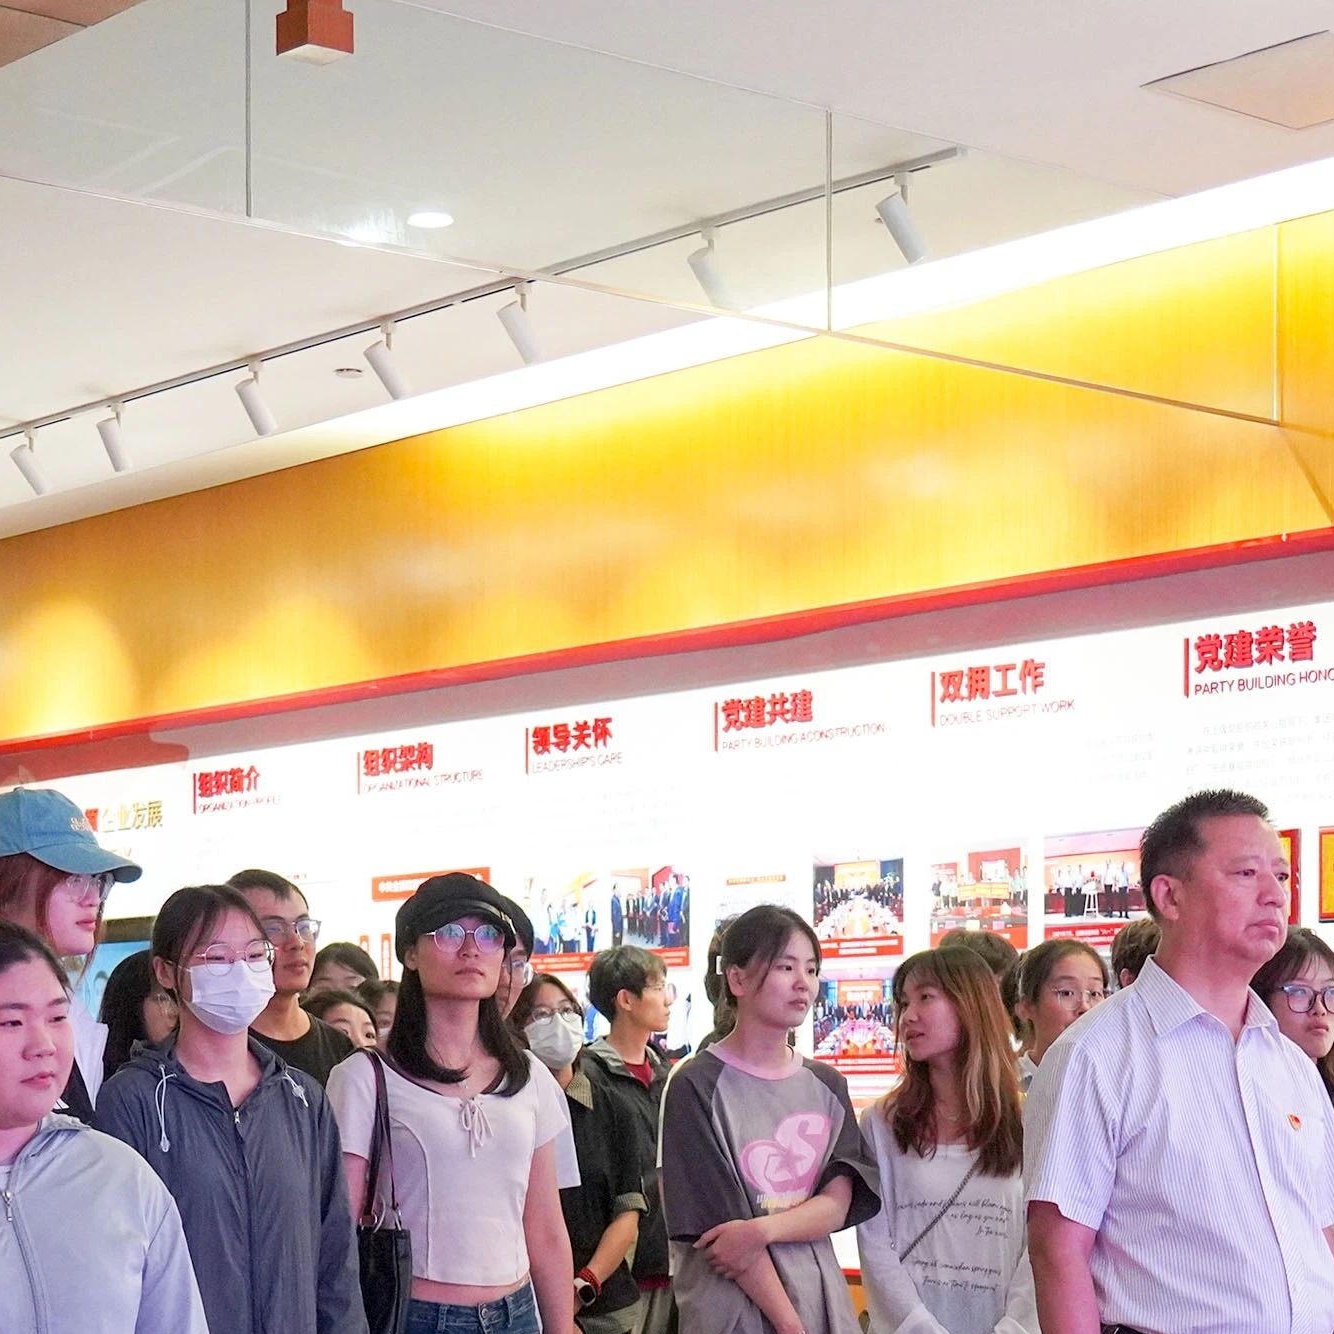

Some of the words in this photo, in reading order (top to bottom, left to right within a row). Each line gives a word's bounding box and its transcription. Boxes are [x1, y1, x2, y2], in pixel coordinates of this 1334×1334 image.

[1194, 620, 1317, 674] 党建荣誉
[939, 658, 1045, 703] 双拥工作
[1194, 679, 1235, 697] PARTY
[1237, 672, 1296, 692] BUILDING
[721, 689, 813, 734] 党建共建
[939, 709, 983, 726] DOUBLE
[986, 703, 1038, 721] SUPPORT
[1040, 698, 1076, 713] WORK
[532, 716, 613, 755] 领导关怀
[363, 742, 434, 777] 组织架构
